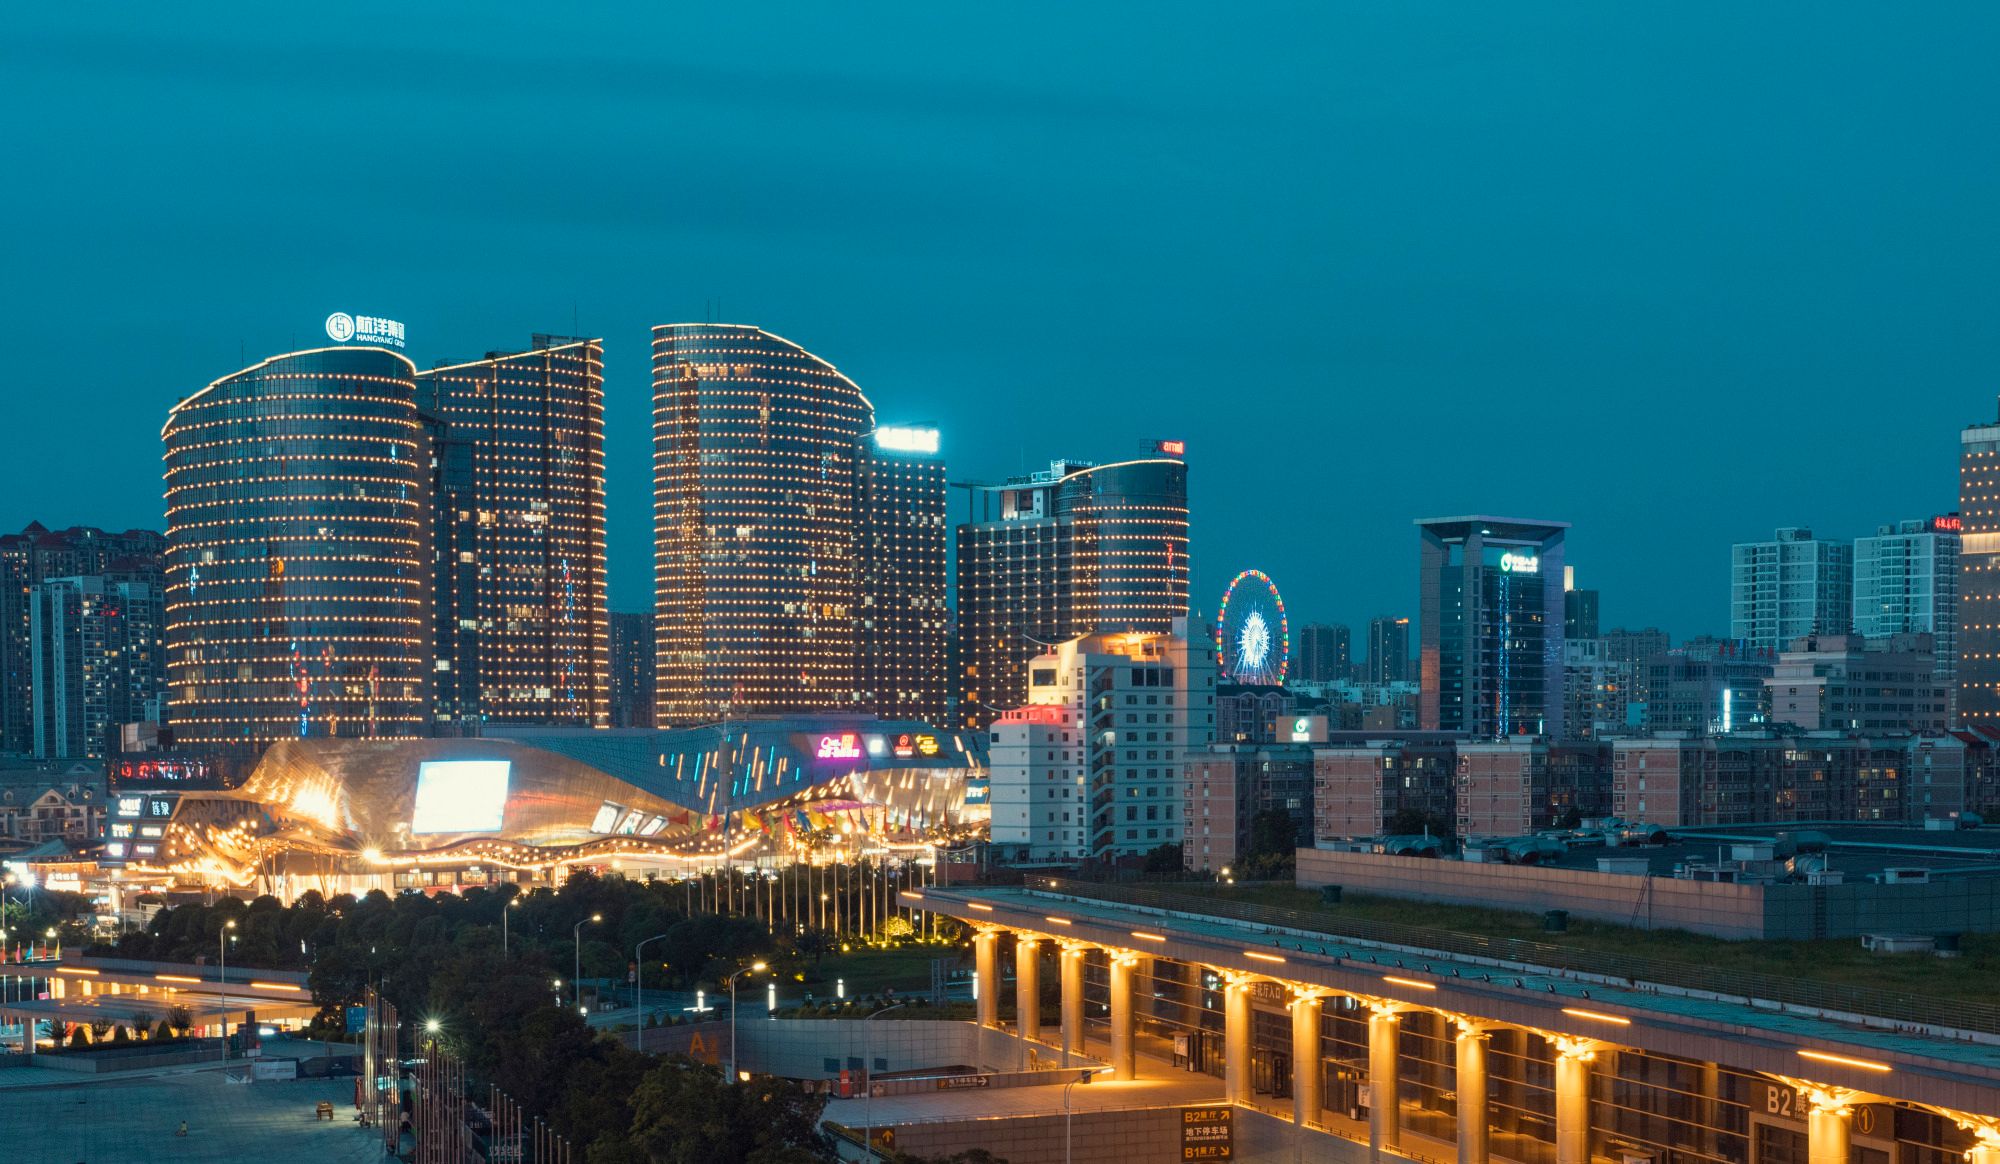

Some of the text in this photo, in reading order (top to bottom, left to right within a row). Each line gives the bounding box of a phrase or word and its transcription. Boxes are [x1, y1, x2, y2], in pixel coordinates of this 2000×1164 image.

[1185, 1126, 1228, 1136] 地下停车场
